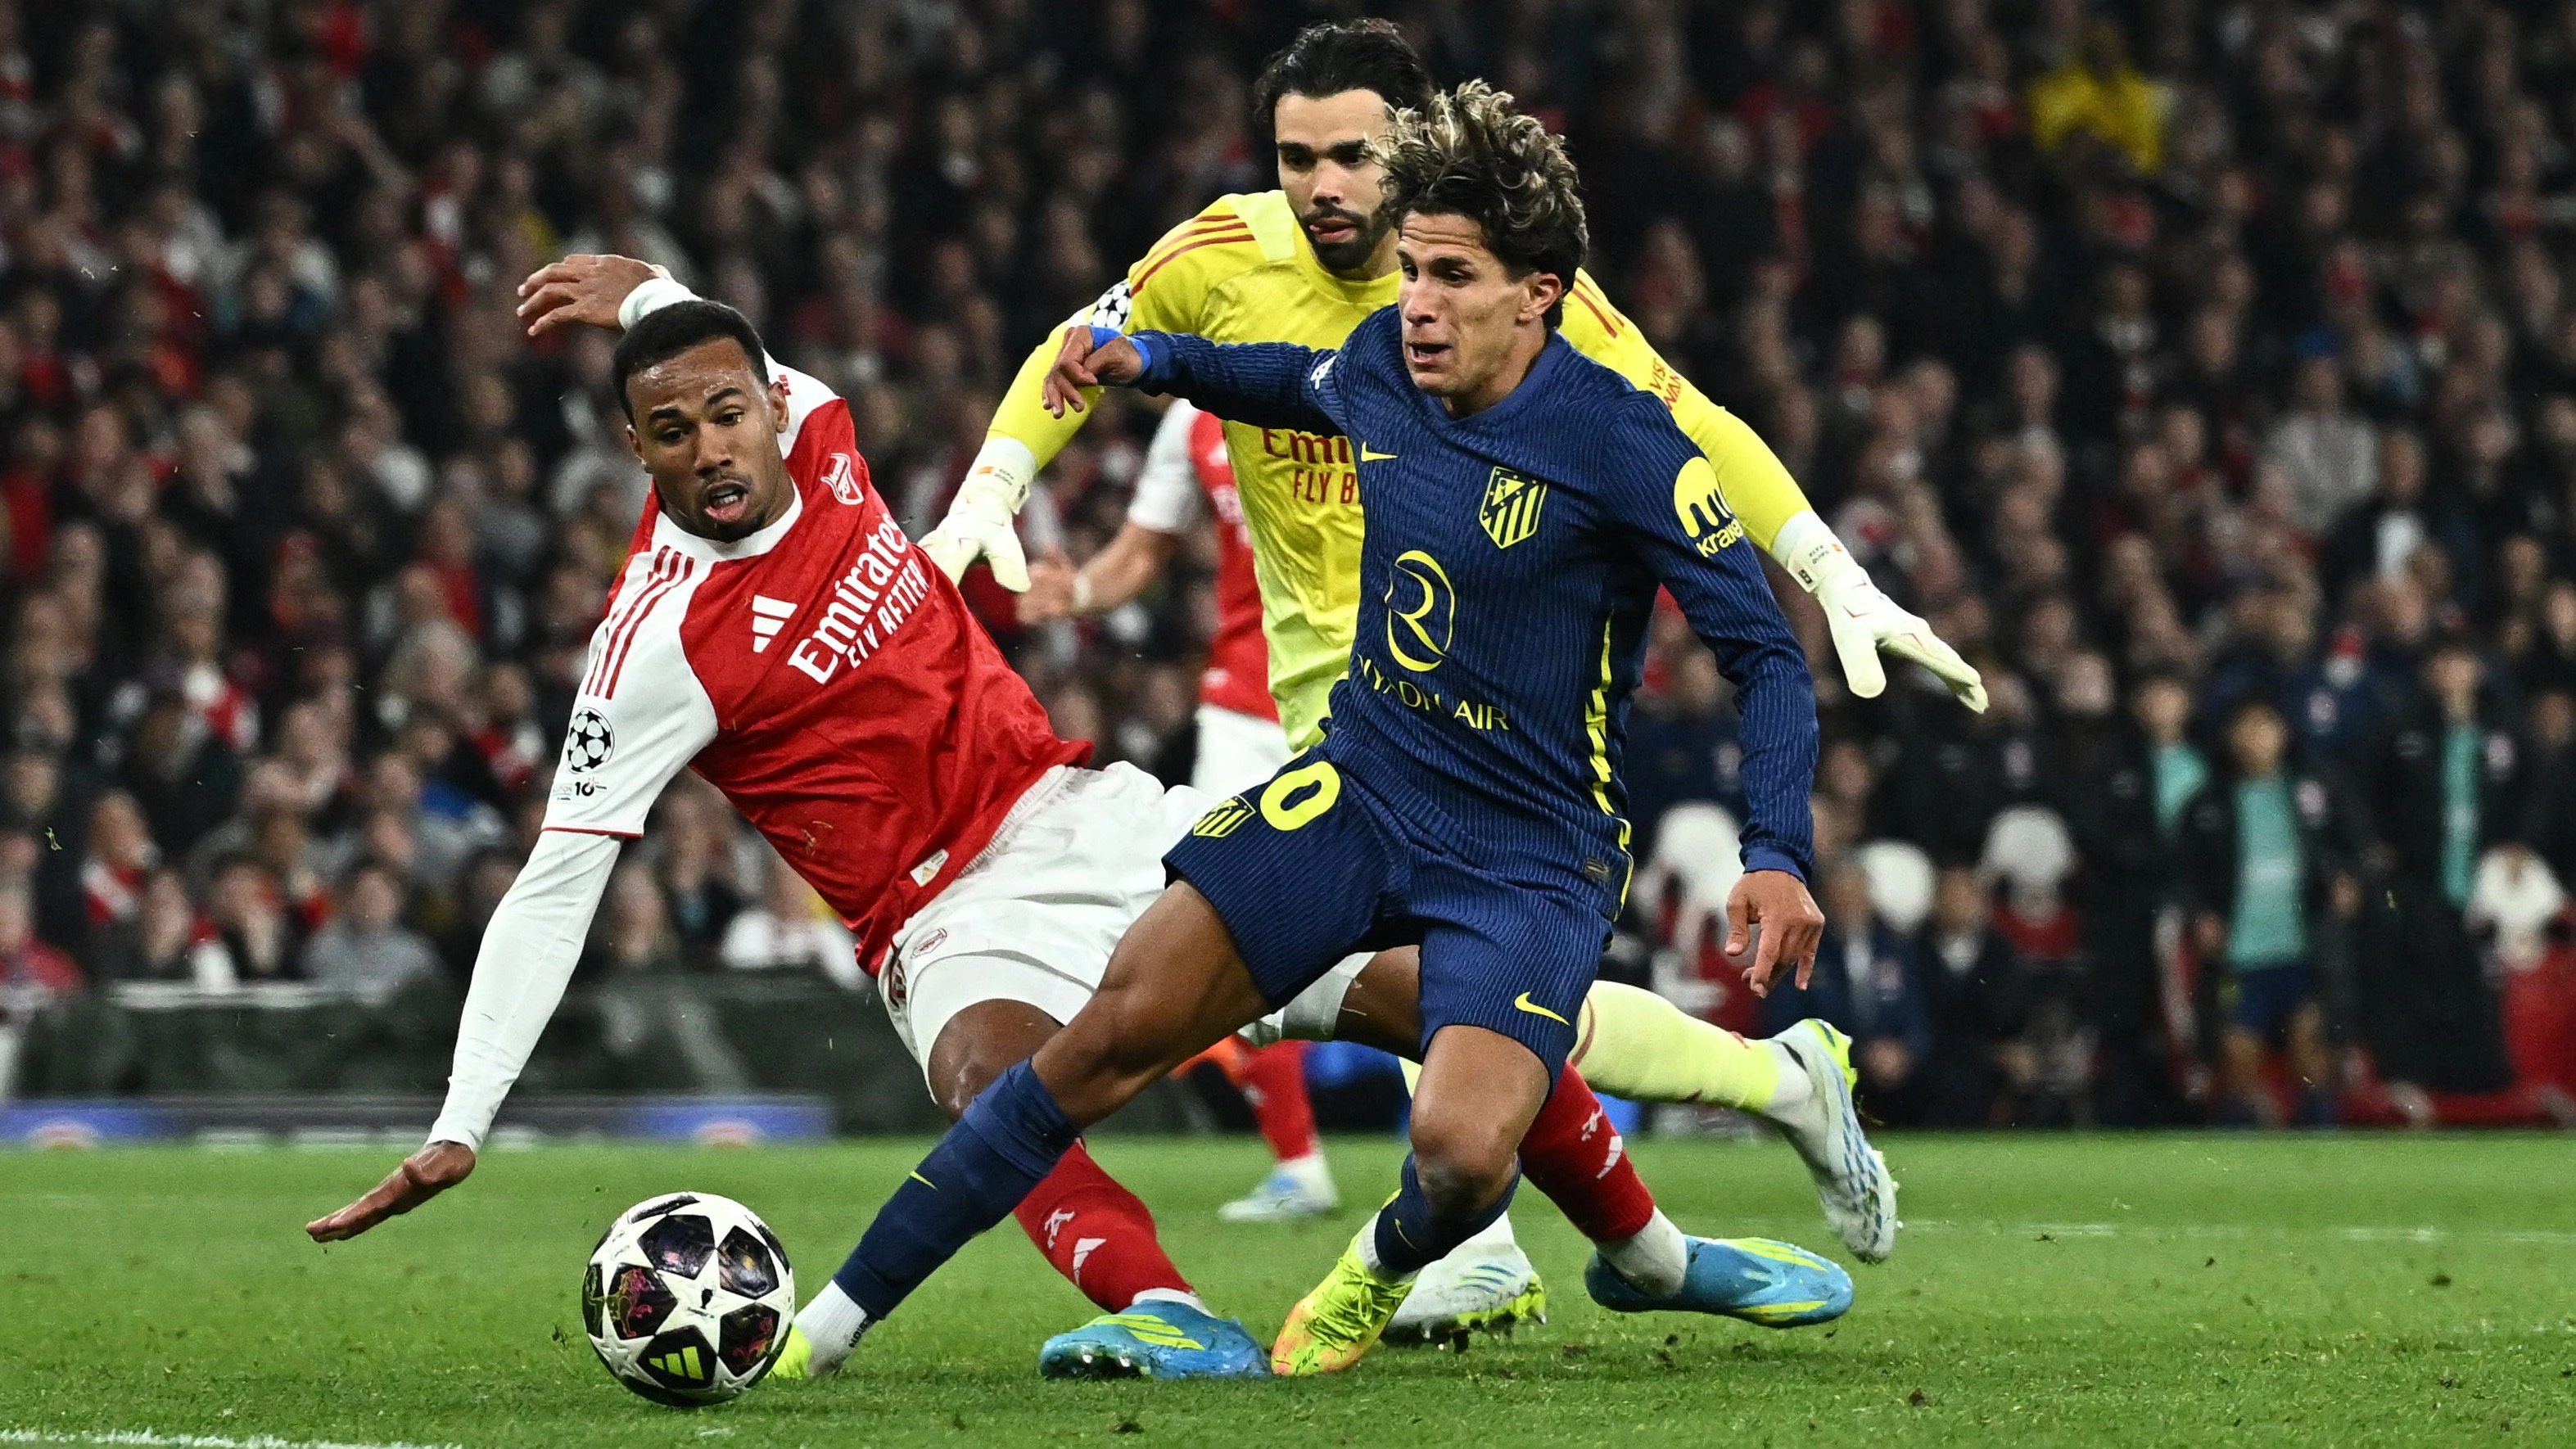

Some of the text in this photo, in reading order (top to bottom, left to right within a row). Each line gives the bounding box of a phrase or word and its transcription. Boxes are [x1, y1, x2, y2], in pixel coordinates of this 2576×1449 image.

[1293, 467, 1332, 503] FLY
[1695, 517, 1744, 558] krake
[1453, 683, 1510, 731] AIR
